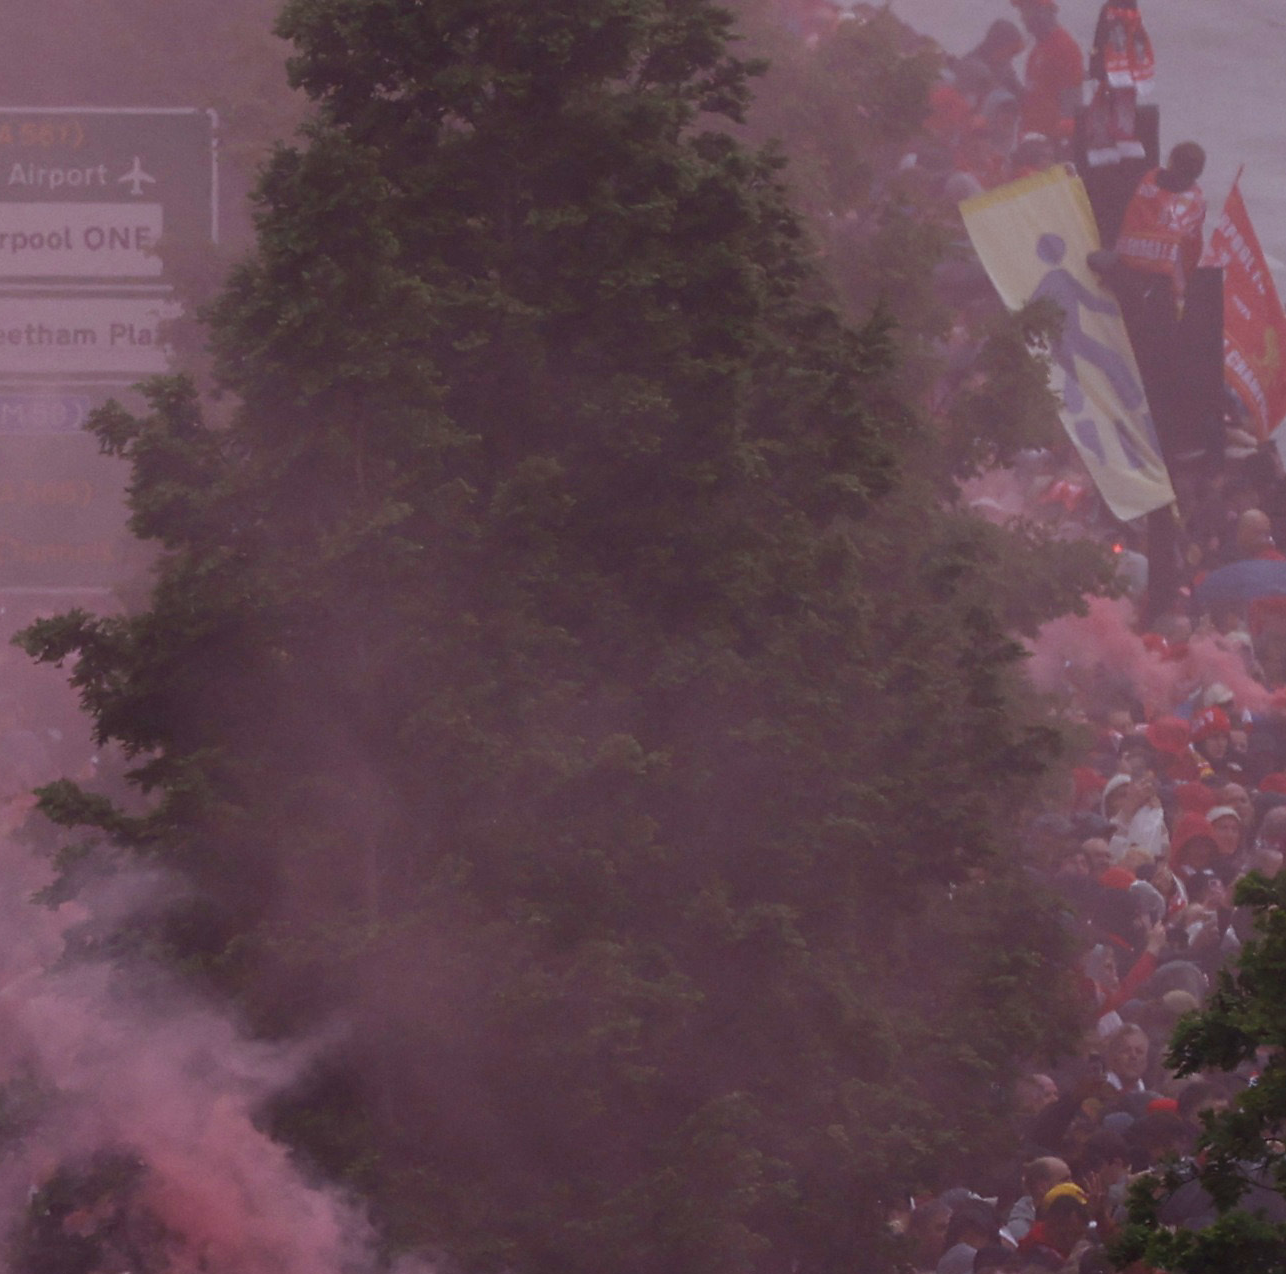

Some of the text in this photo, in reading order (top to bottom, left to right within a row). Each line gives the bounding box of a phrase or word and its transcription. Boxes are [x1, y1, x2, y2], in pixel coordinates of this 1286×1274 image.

[8, 162, 108, 189] Airport
[83, 226, 151, 251] ONE
[109, 322, 159, 346] Pla
